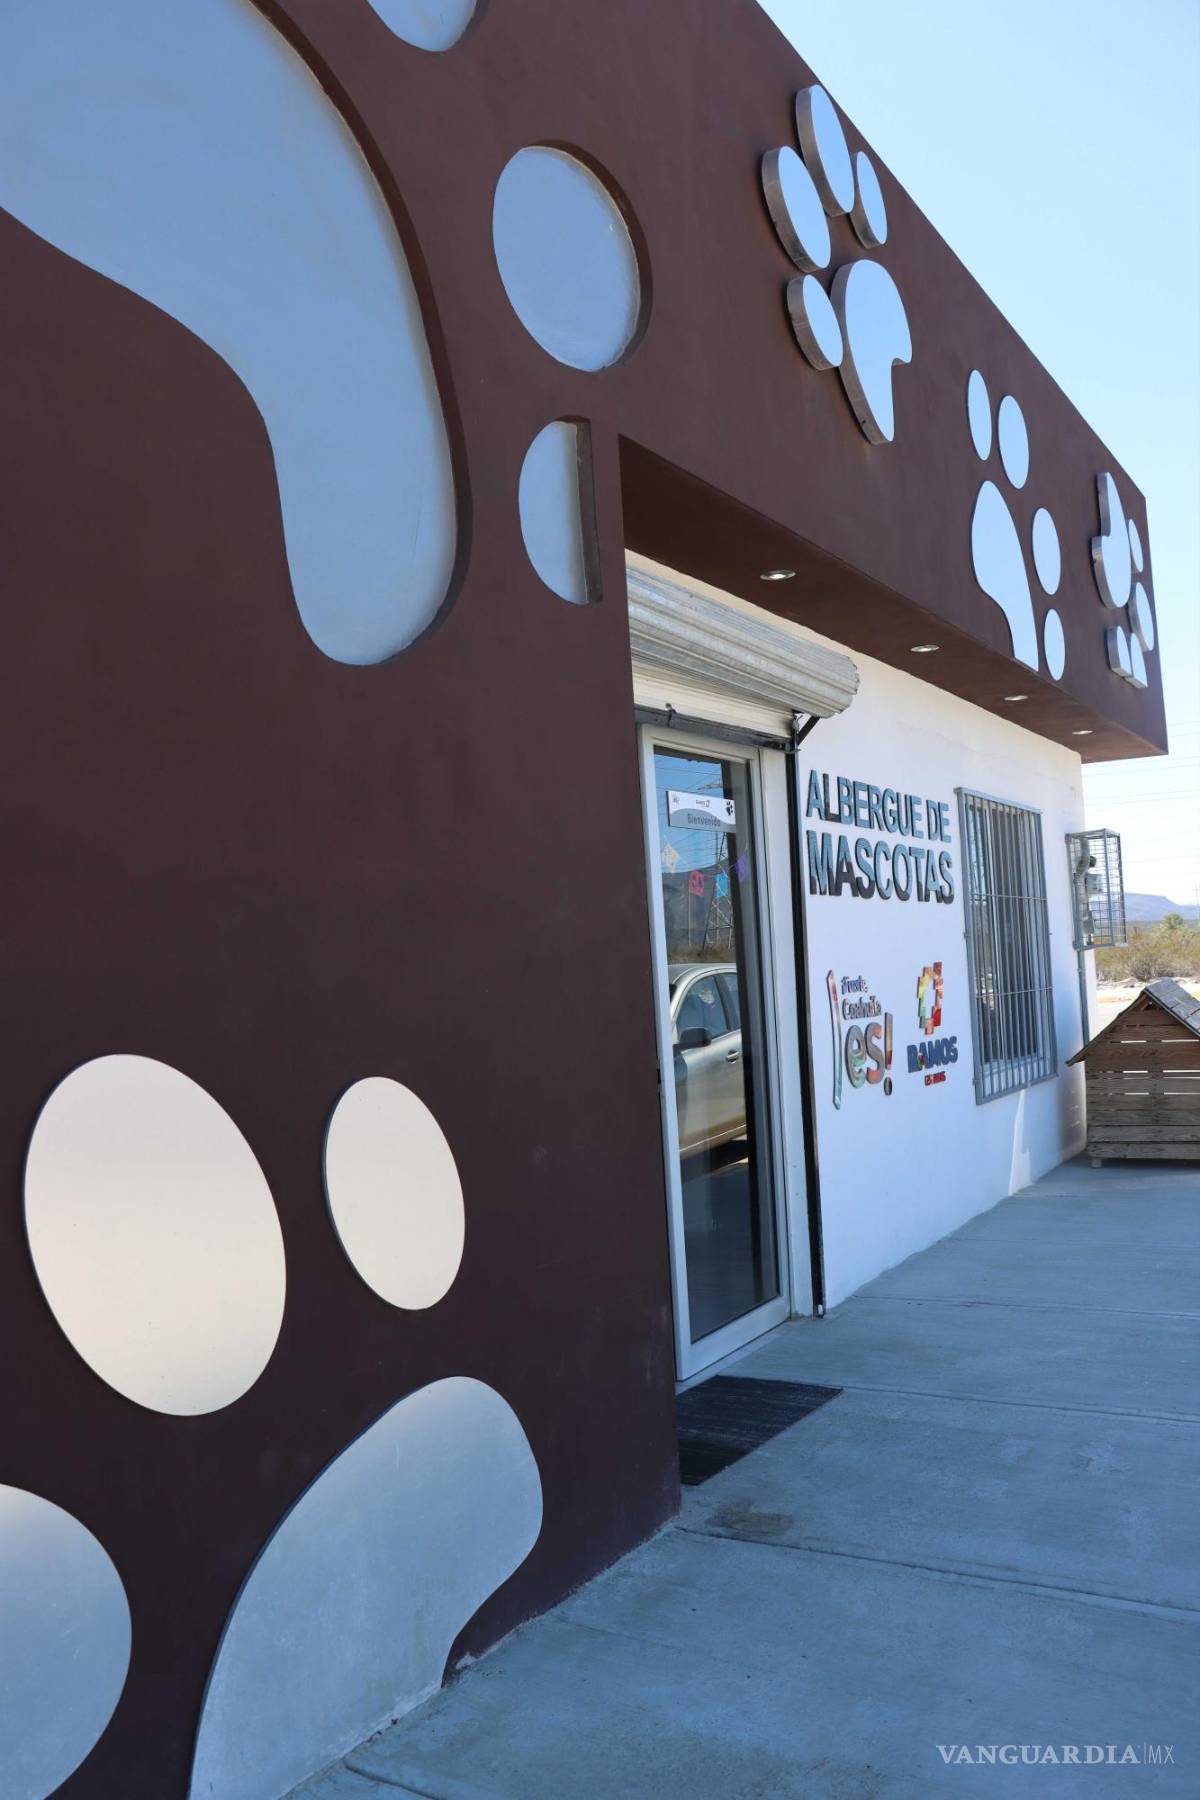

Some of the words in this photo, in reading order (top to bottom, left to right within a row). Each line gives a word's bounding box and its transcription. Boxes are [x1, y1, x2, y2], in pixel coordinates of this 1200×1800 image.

[806, 769, 924, 839] ALBERGUE
[926, 799, 952, 843] DE
[806, 830, 954, 905] MASCOTAS
[906, 1036, 958, 1073] RAMOS
